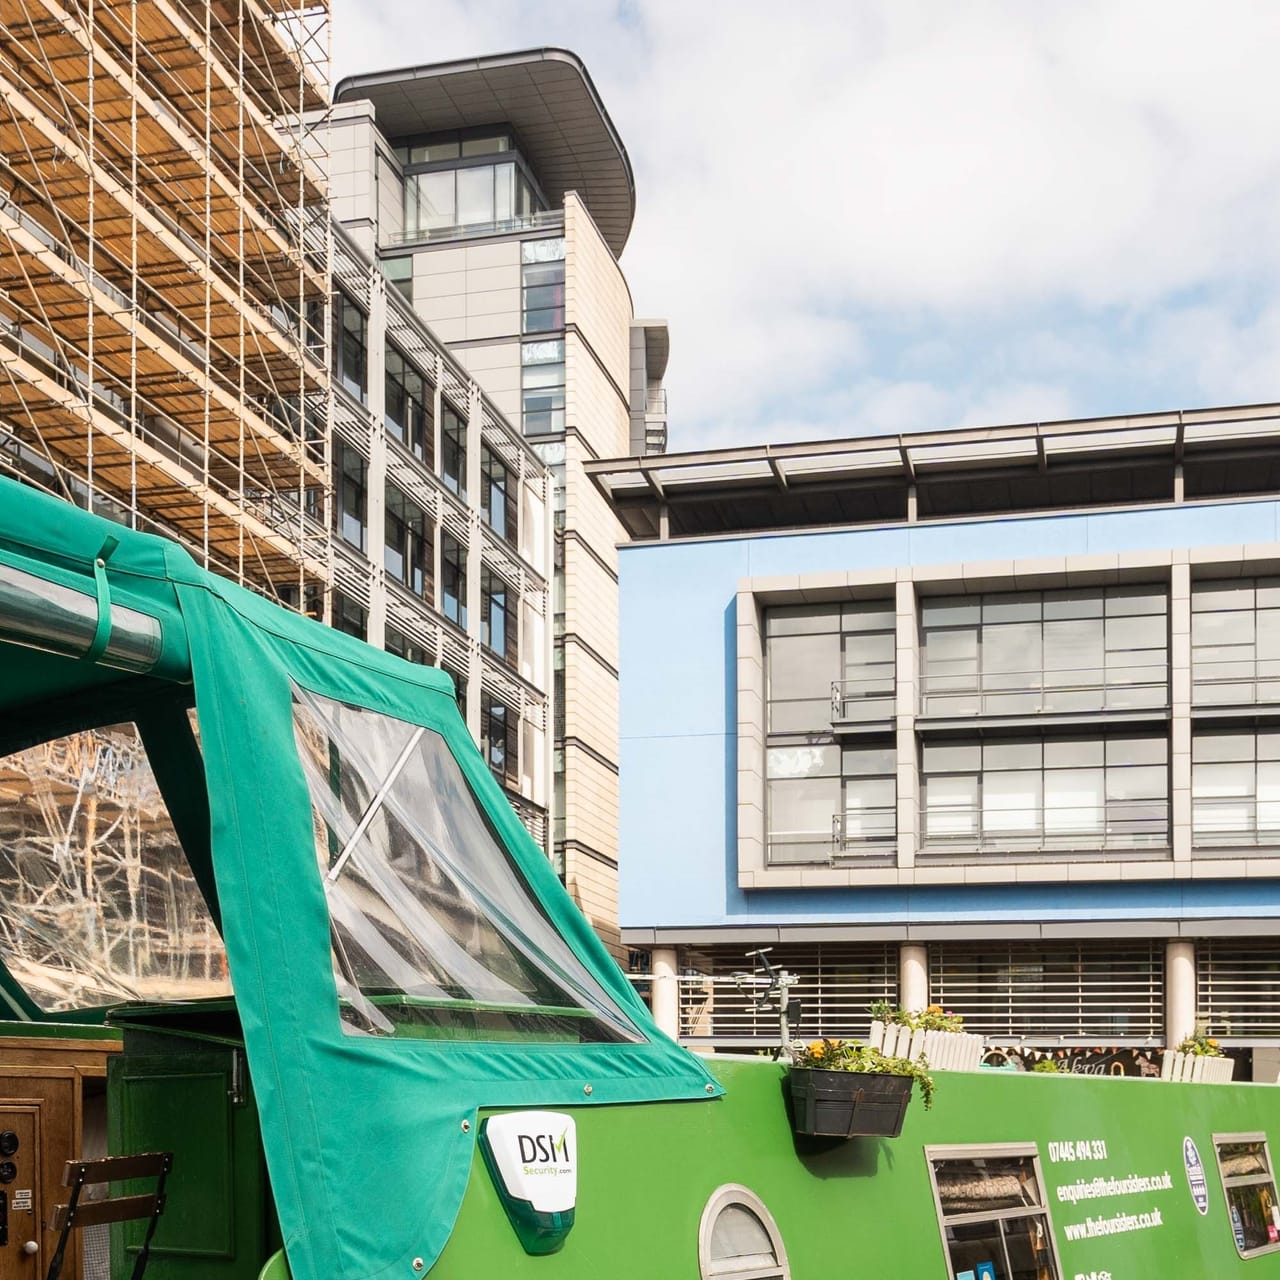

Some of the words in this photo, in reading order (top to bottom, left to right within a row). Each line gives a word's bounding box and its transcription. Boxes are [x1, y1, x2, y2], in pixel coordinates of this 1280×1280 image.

[1048, 1141, 1076, 1163] 07445
[1076, 1140, 1092, 1161] 494
[1091, 1140, 1107, 1160] 331
[1056, 1171, 1173, 1205] enquiries@thefoursisters.co.uk
[1064, 1207, 1163, 1241] www.thefoursisters.co.uk
